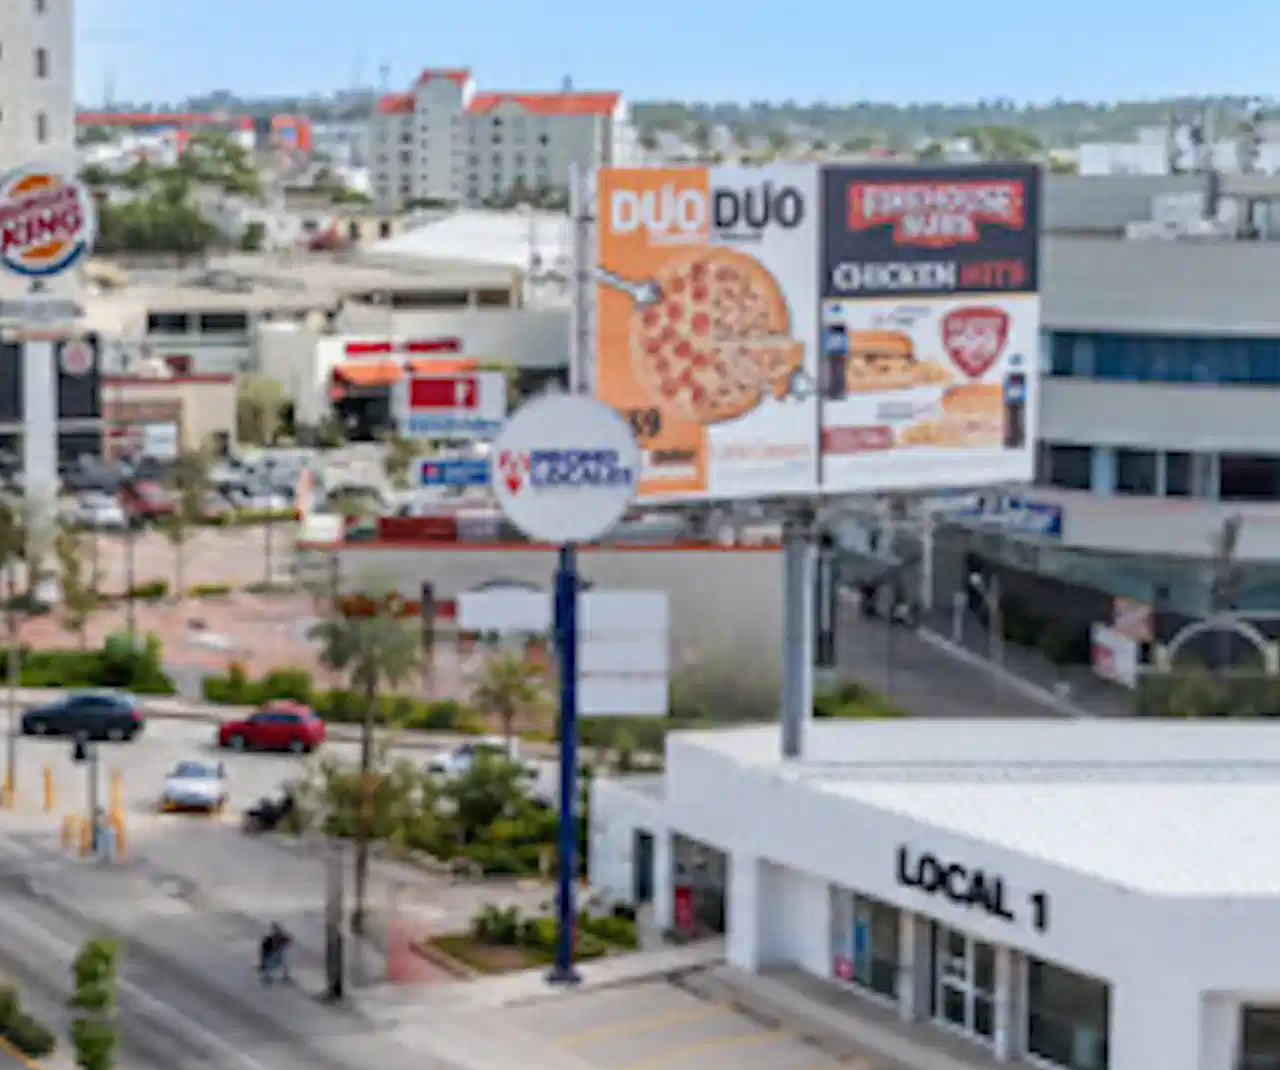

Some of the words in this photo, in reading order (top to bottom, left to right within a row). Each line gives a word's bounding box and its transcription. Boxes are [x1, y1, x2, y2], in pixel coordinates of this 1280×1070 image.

[1, 203, 82, 254] KING
[832, 261, 958, 290] CHICKEN
[531, 467, 632, 487] LOCALES
[897, 845, 1015, 921] LOCAL
[1029, 888, 1050, 934] 1
